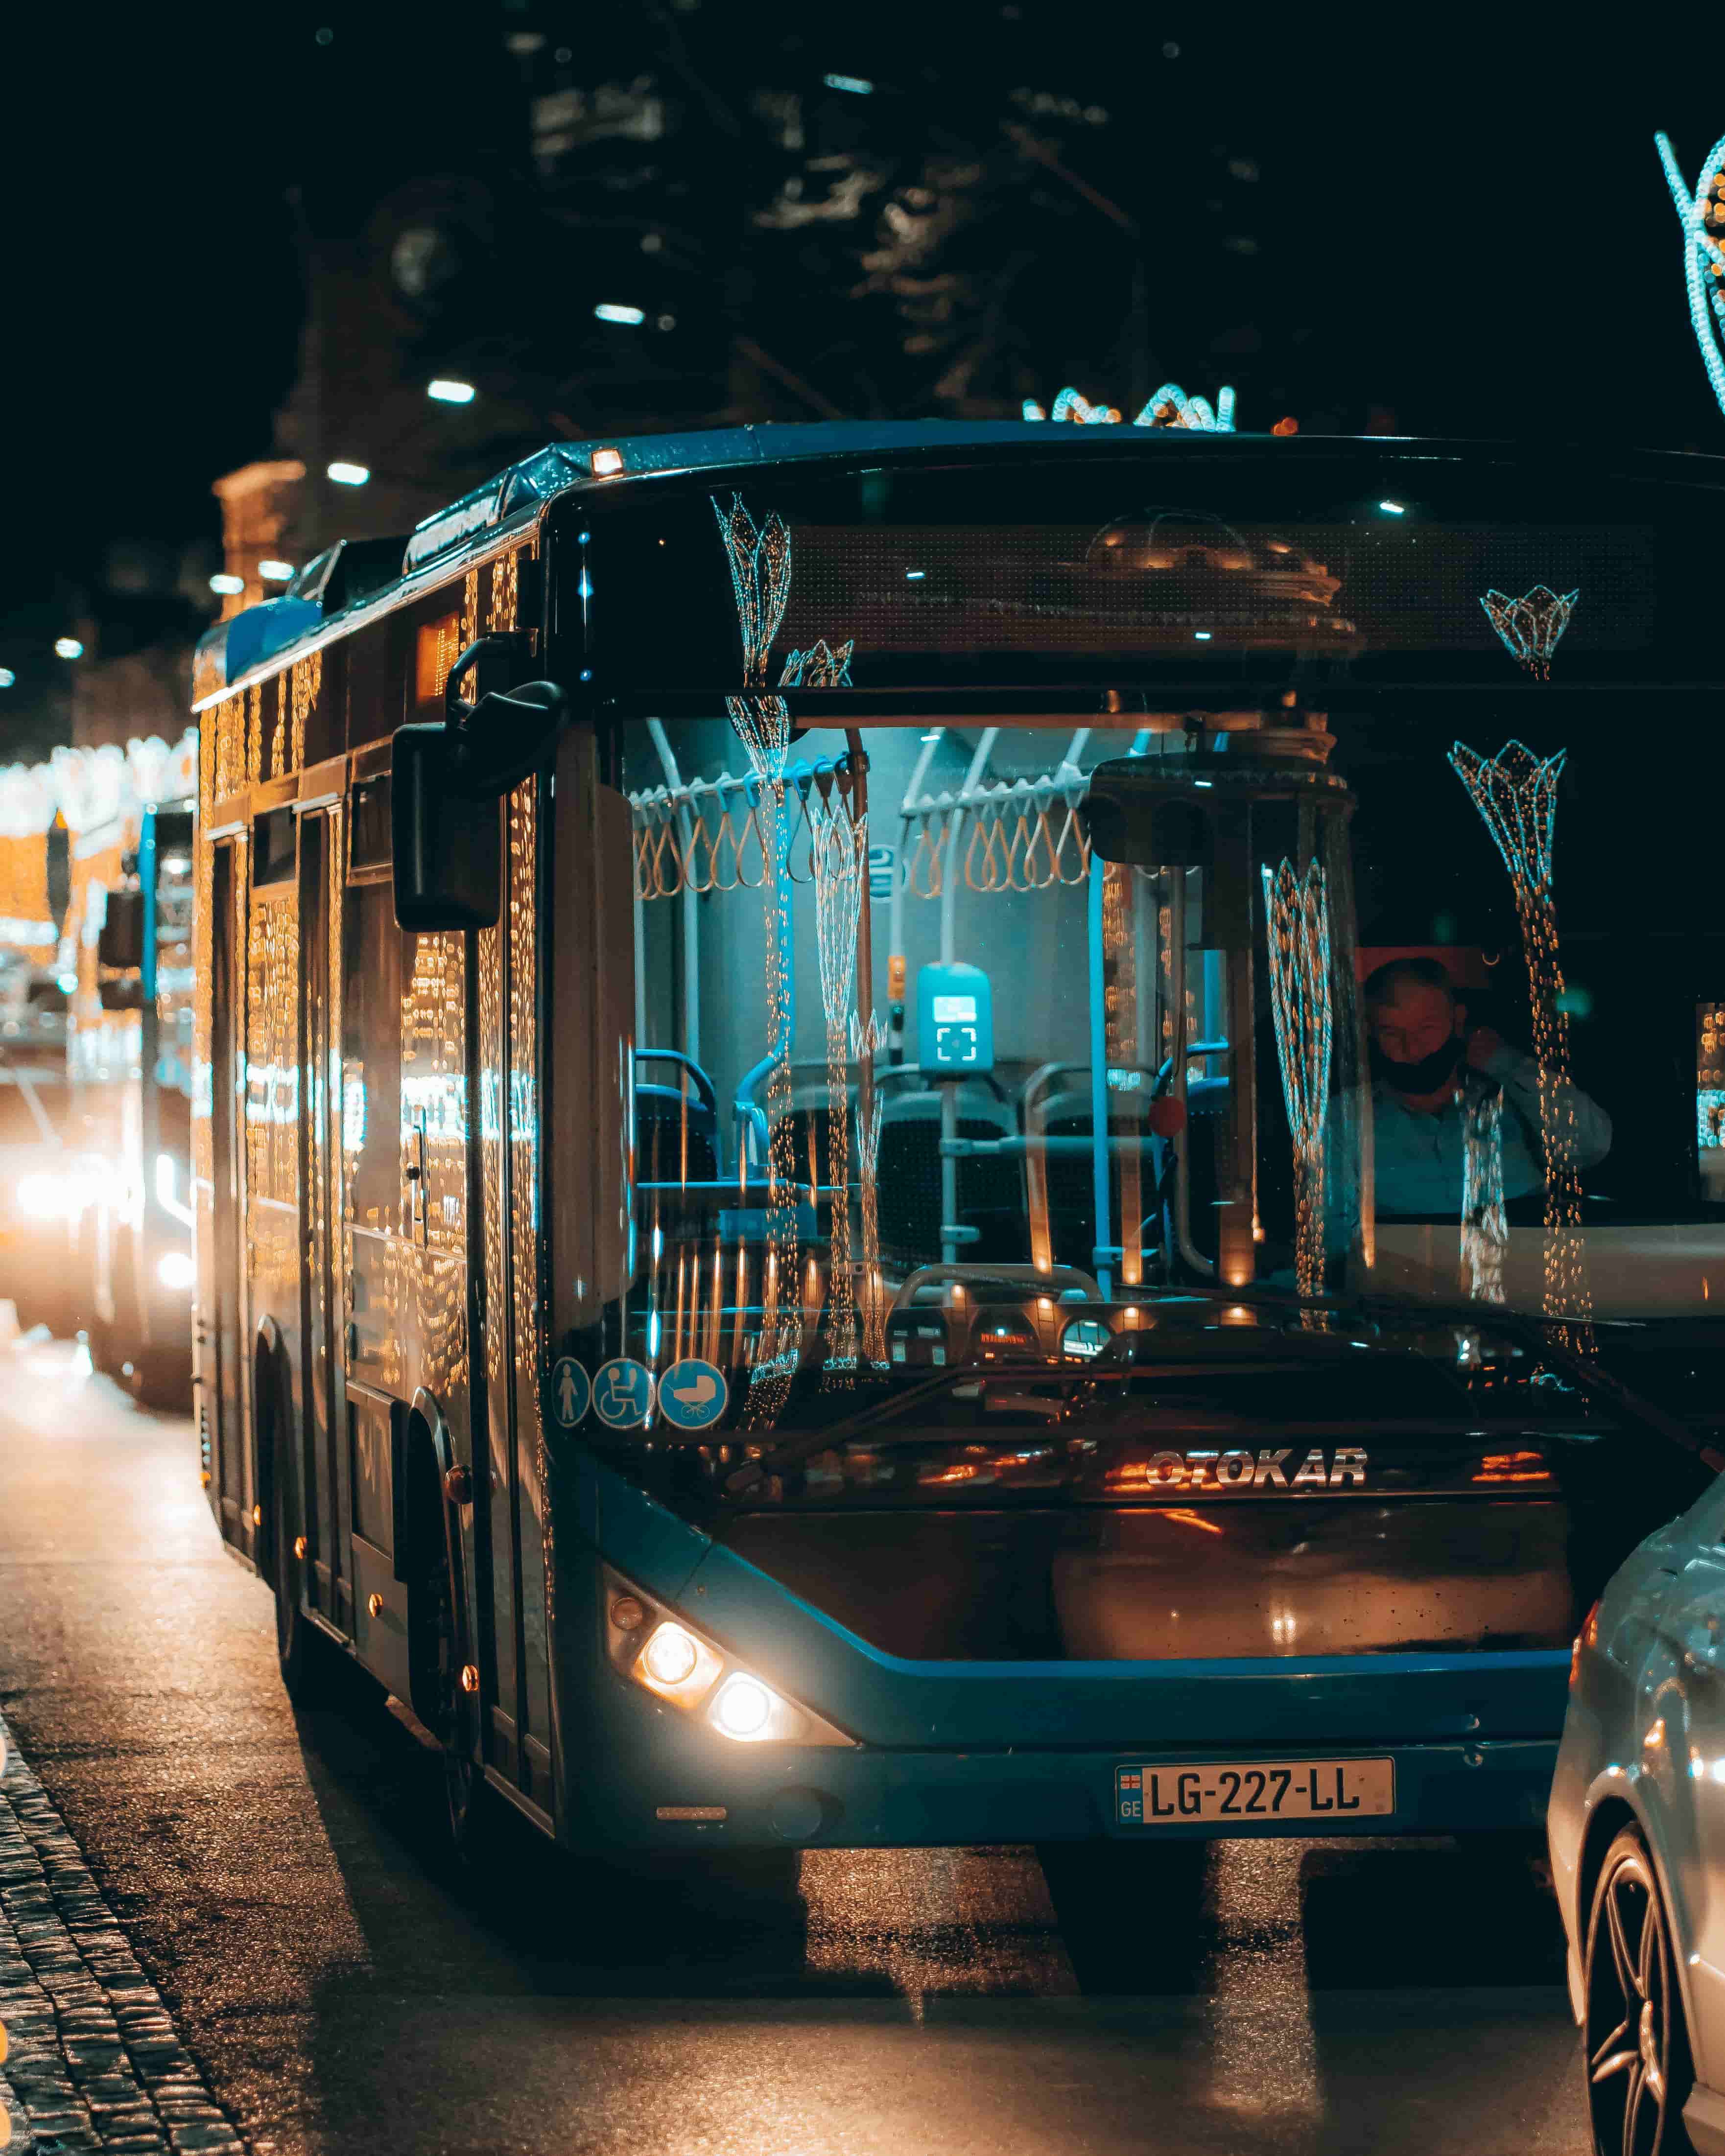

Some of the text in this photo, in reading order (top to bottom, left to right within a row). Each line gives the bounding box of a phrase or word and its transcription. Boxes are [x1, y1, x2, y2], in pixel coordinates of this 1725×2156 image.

[1146, 1448, 1368, 1488] OTOKAR
[1121, 1801, 1141, 1817] GE
[1151, 1767, 1360, 1816] LG-227-LL
